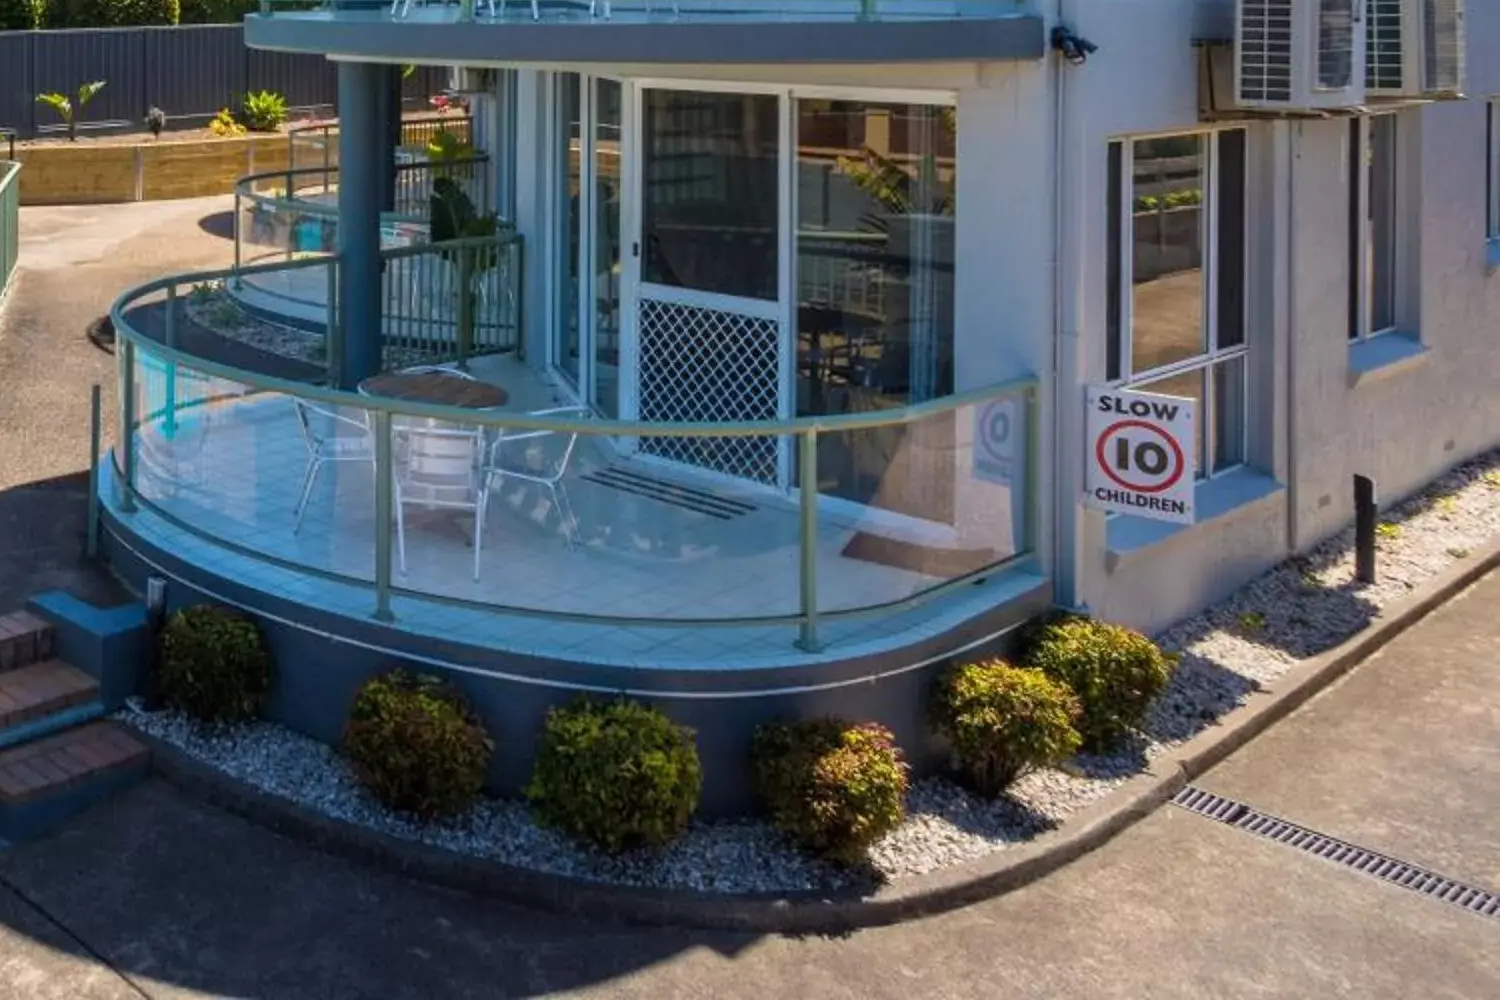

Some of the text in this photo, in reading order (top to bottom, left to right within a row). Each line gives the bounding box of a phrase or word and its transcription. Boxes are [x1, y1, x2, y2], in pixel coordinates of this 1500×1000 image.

[1098, 395, 1179, 422] SLOW
[1116, 437, 1168, 475] 10
[1095, 486, 1185, 514] CHILDREN
